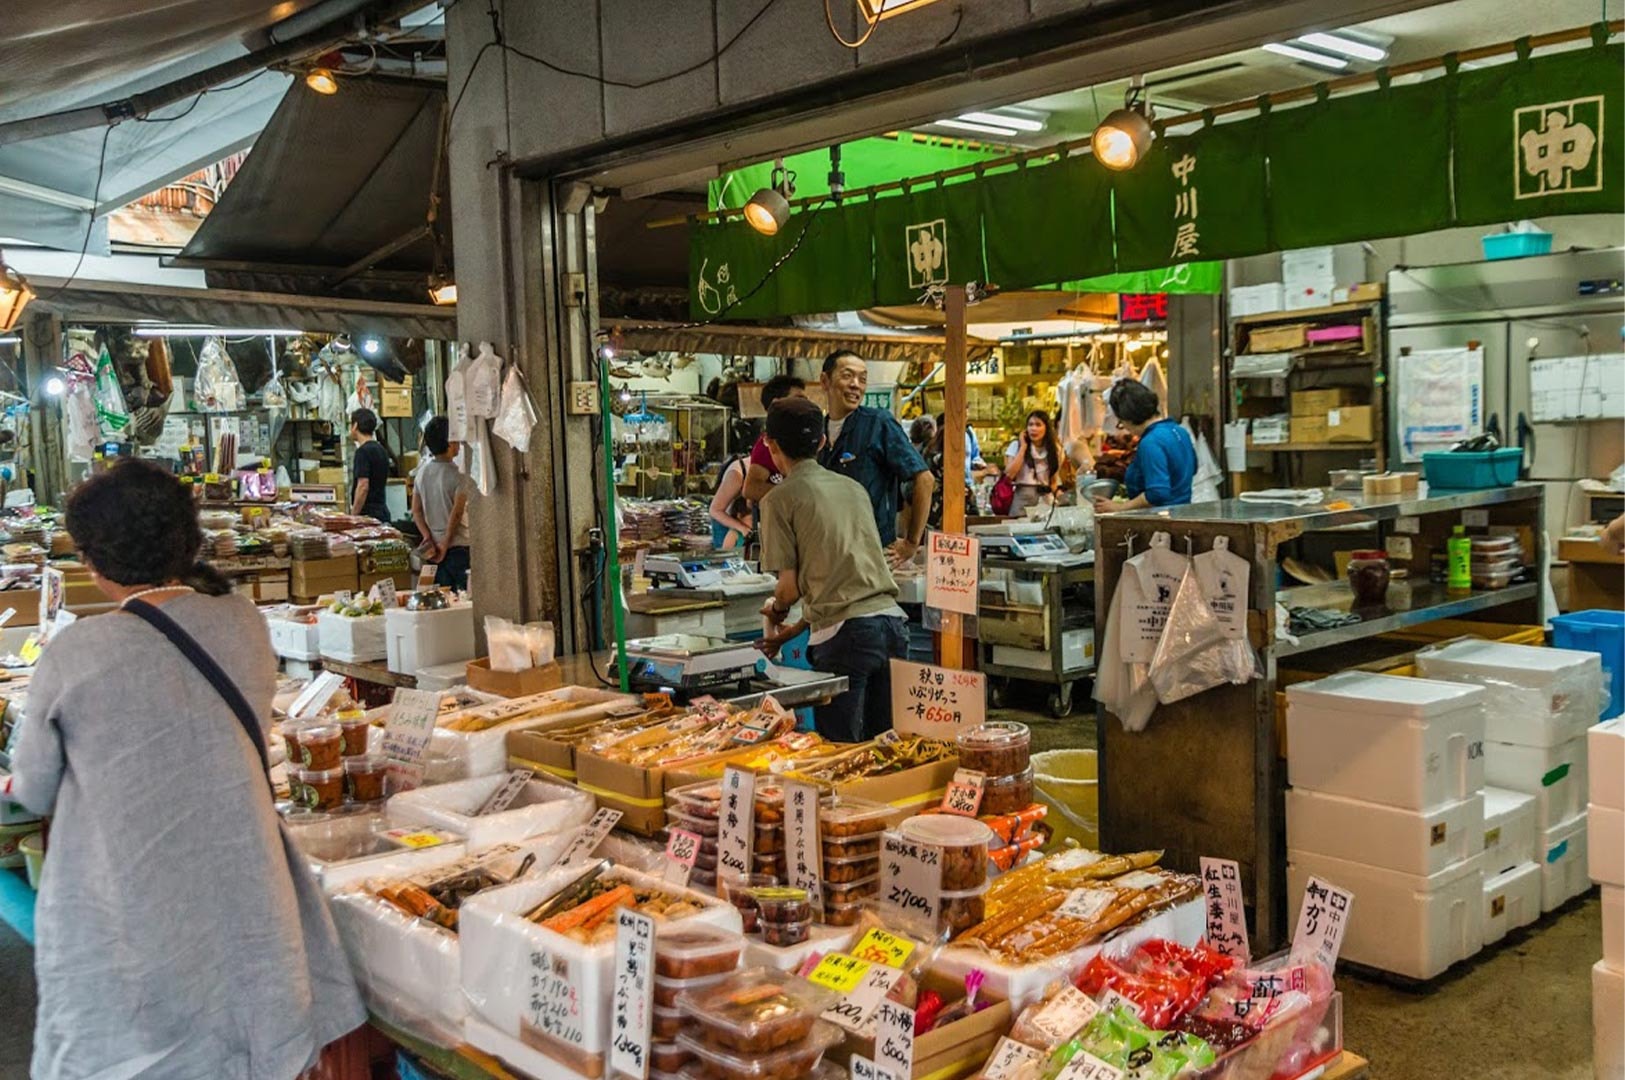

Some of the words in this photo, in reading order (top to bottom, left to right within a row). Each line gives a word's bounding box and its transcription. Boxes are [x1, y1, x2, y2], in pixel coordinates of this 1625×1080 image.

[1171, 154, 1200, 259] 中川屋
[918, 668, 945, 685] 秋田
[920, 848, 938, 866] 8%
[1225, 882, 1240, 925] 中川屋
